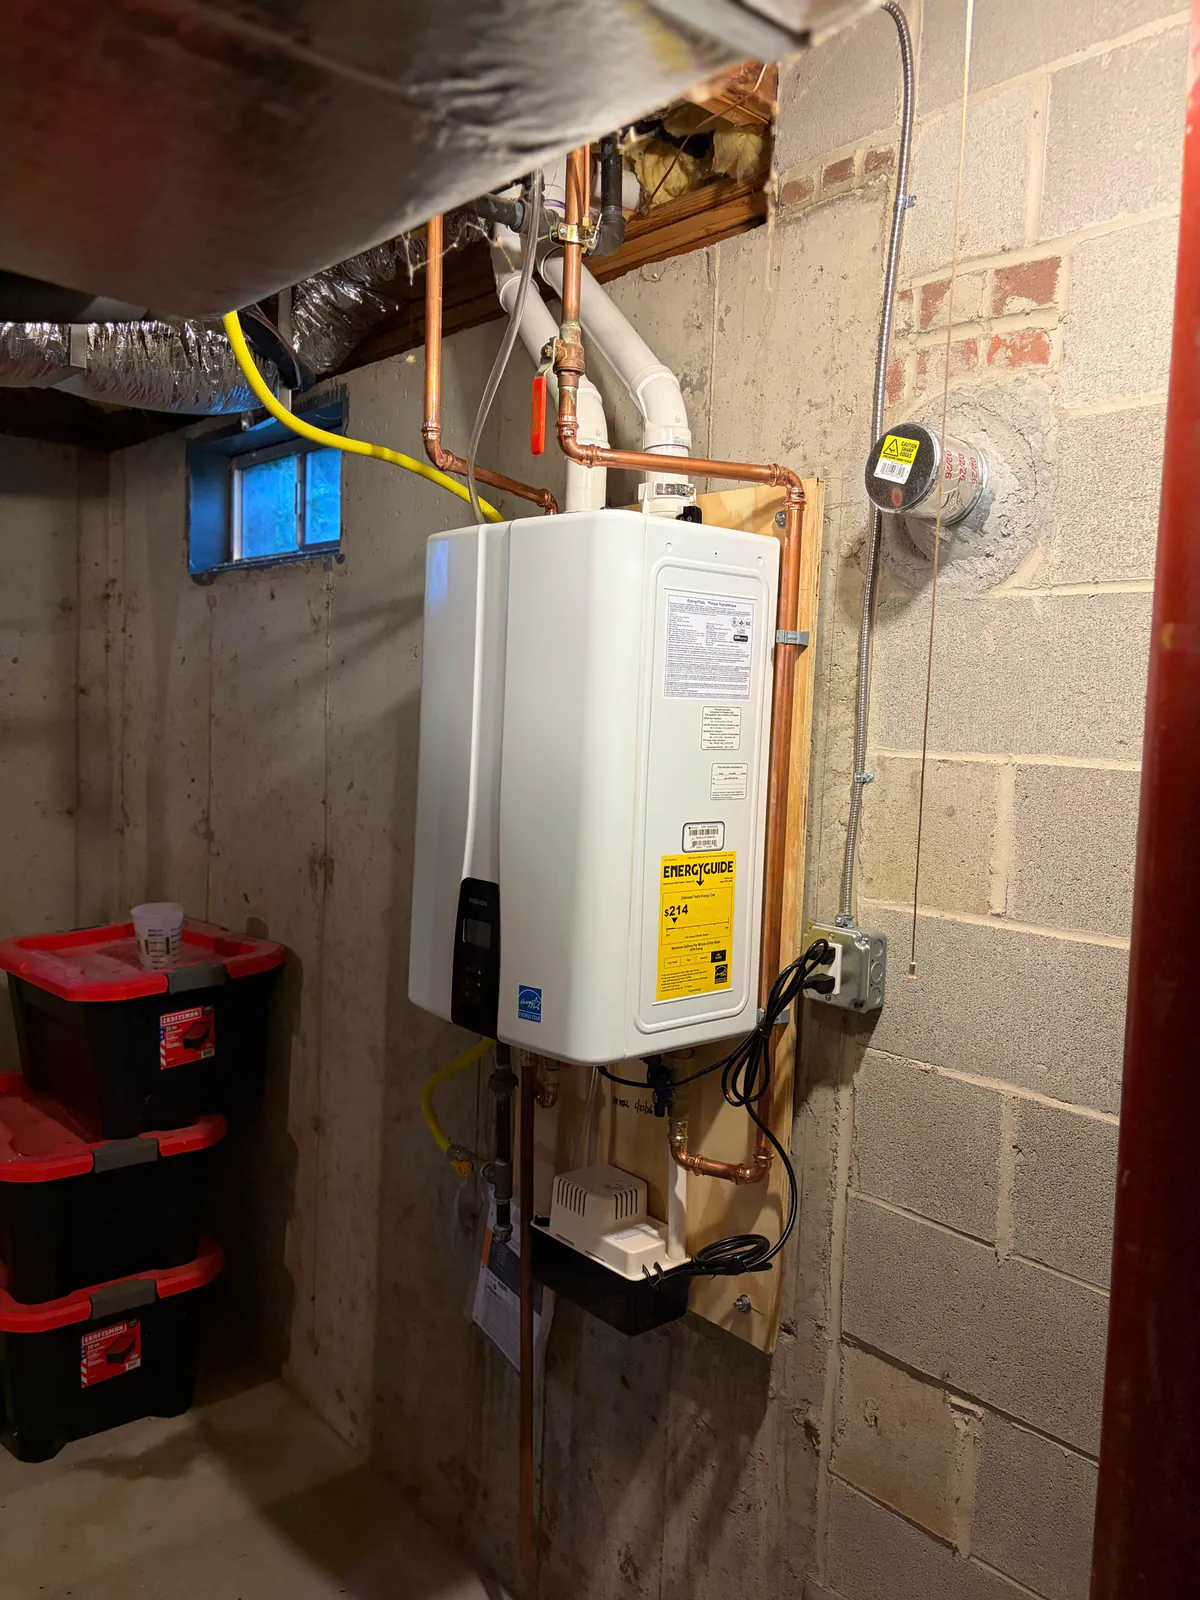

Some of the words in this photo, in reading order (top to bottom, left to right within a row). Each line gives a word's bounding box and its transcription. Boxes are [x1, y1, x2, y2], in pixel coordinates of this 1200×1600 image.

[901, 441, 917, 449] CAUTION
[664, 861, 734, 879] ENERGYGUIDE
[664, 904, 688, 917] $214
[162, 1010, 200, 1024] CRAFTSMAN
[84, 1324, 124, 1343] CRAFTSMAN
